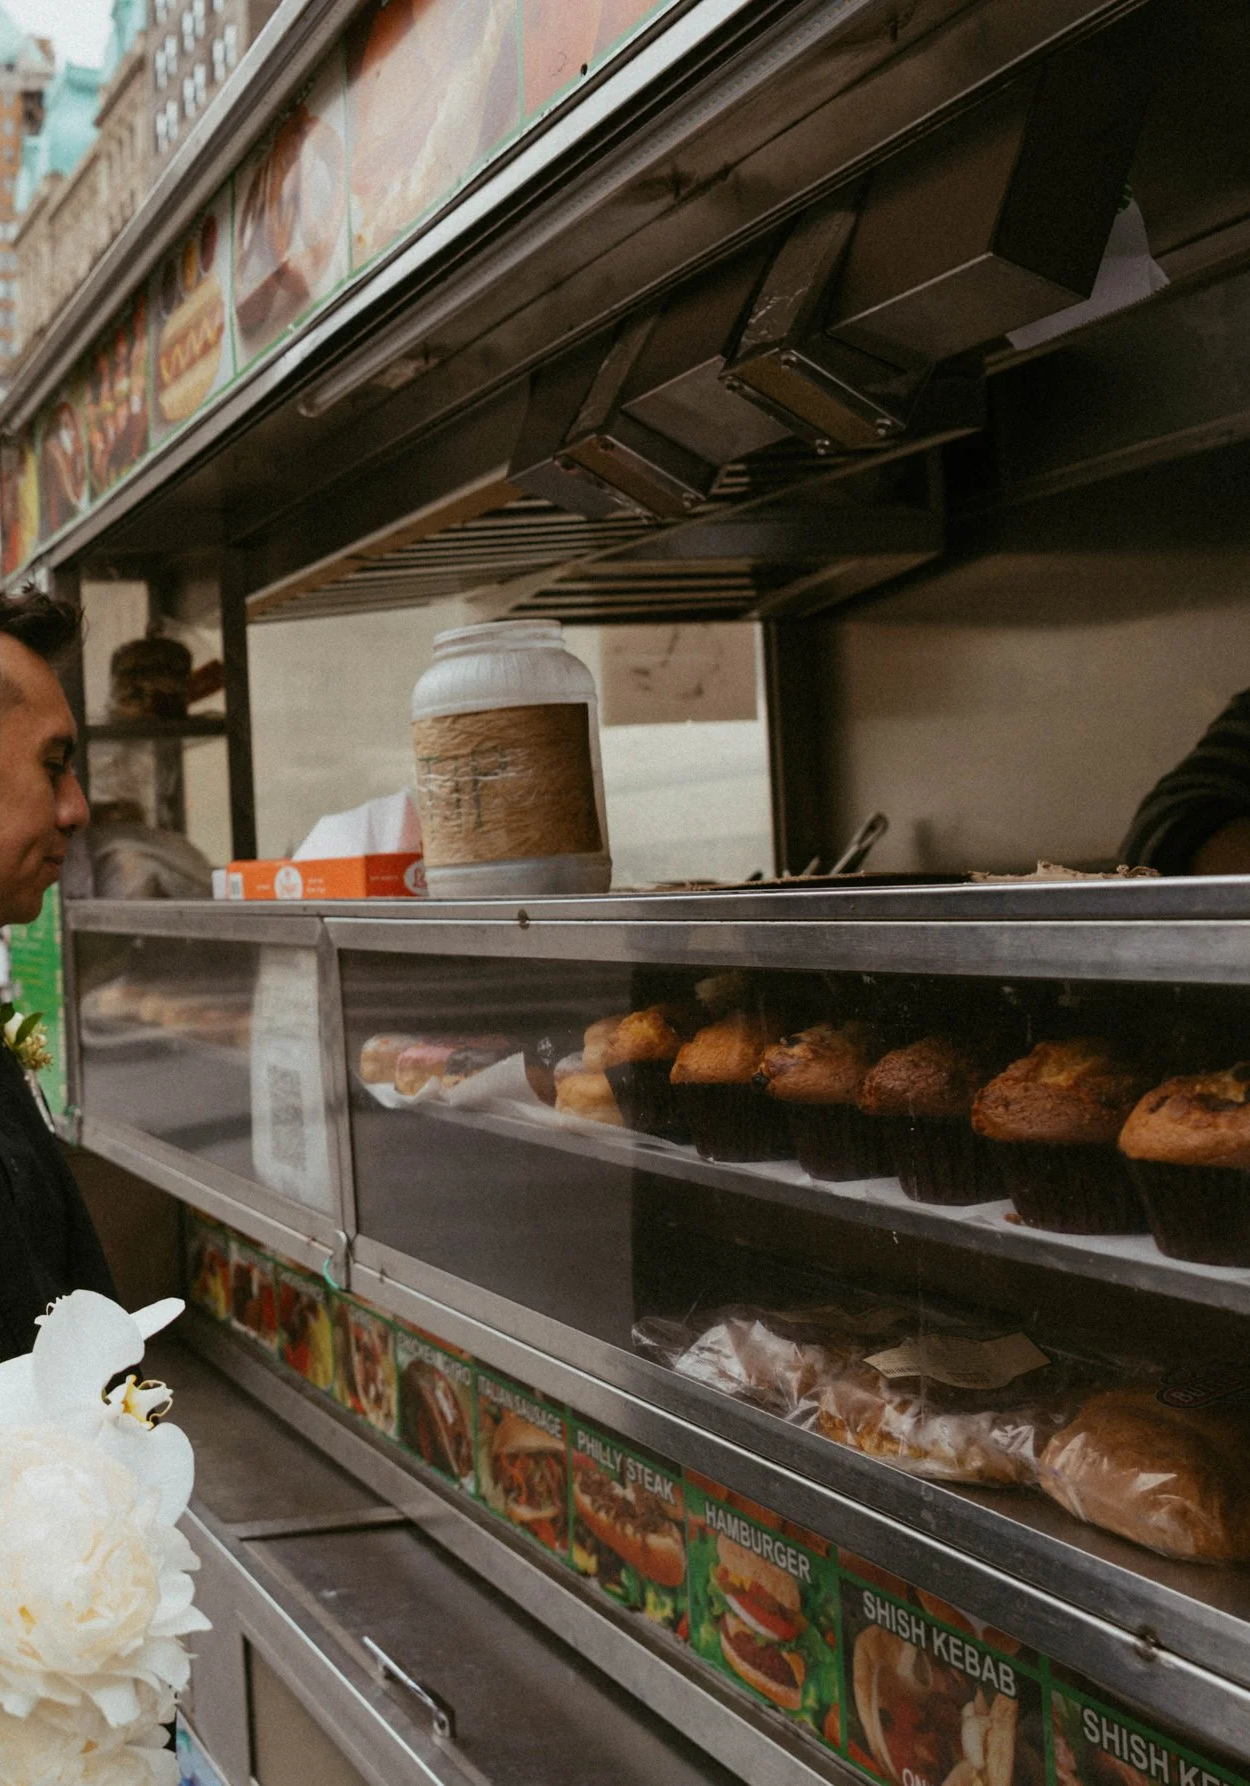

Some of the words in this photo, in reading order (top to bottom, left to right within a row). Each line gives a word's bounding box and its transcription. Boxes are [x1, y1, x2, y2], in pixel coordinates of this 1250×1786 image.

[577, 1430, 623, 1473] PHILLY
[626, 1457, 675, 1504] STEAK
[705, 1501, 811, 1584] HAMBURGER
[862, 1590, 926, 1649] SHISH
[932, 1626, 1017, 1697] KEBAB
[1082, 1708, 1170, 1785] SHISH
